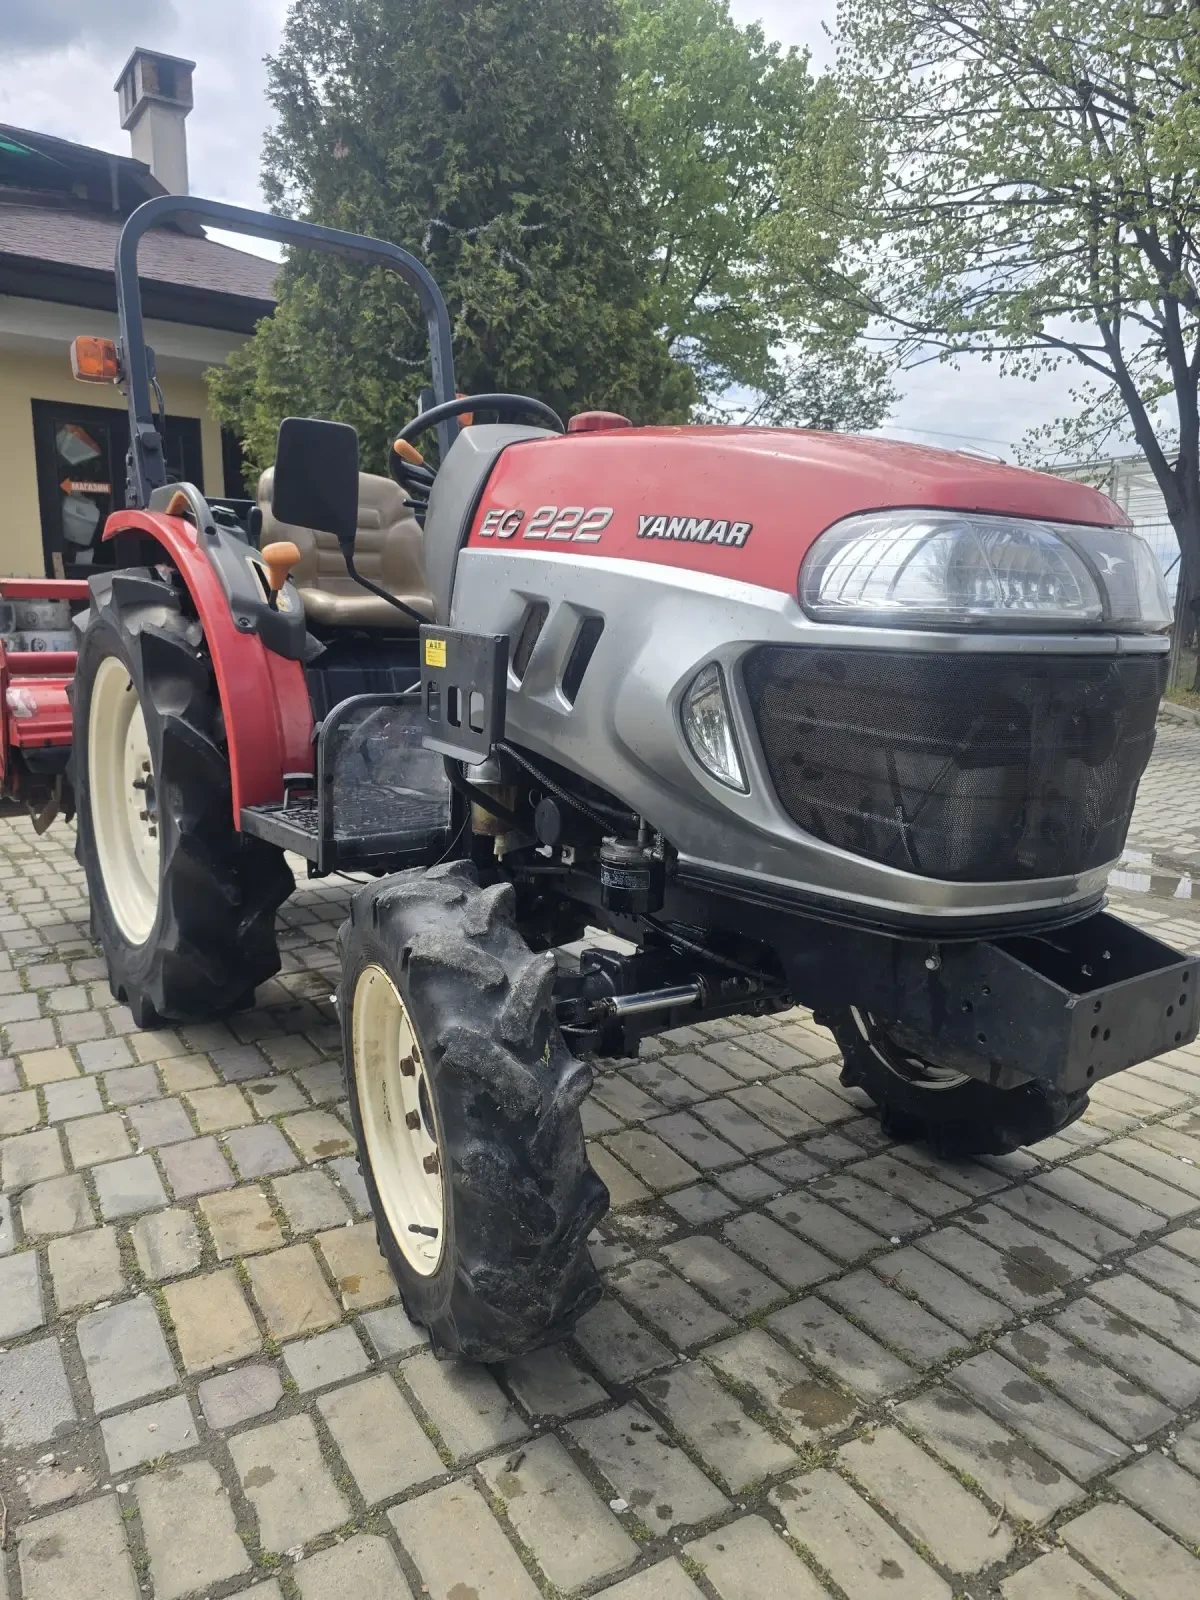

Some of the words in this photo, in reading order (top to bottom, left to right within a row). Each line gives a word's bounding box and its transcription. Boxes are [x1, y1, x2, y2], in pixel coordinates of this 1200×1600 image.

[71, 482, 109, 493] МАГАЗИН
[479, 509, 524, 538] EG
[522, 505, 614, 543] 222
[637, 515, 752, 548] YANMAR
